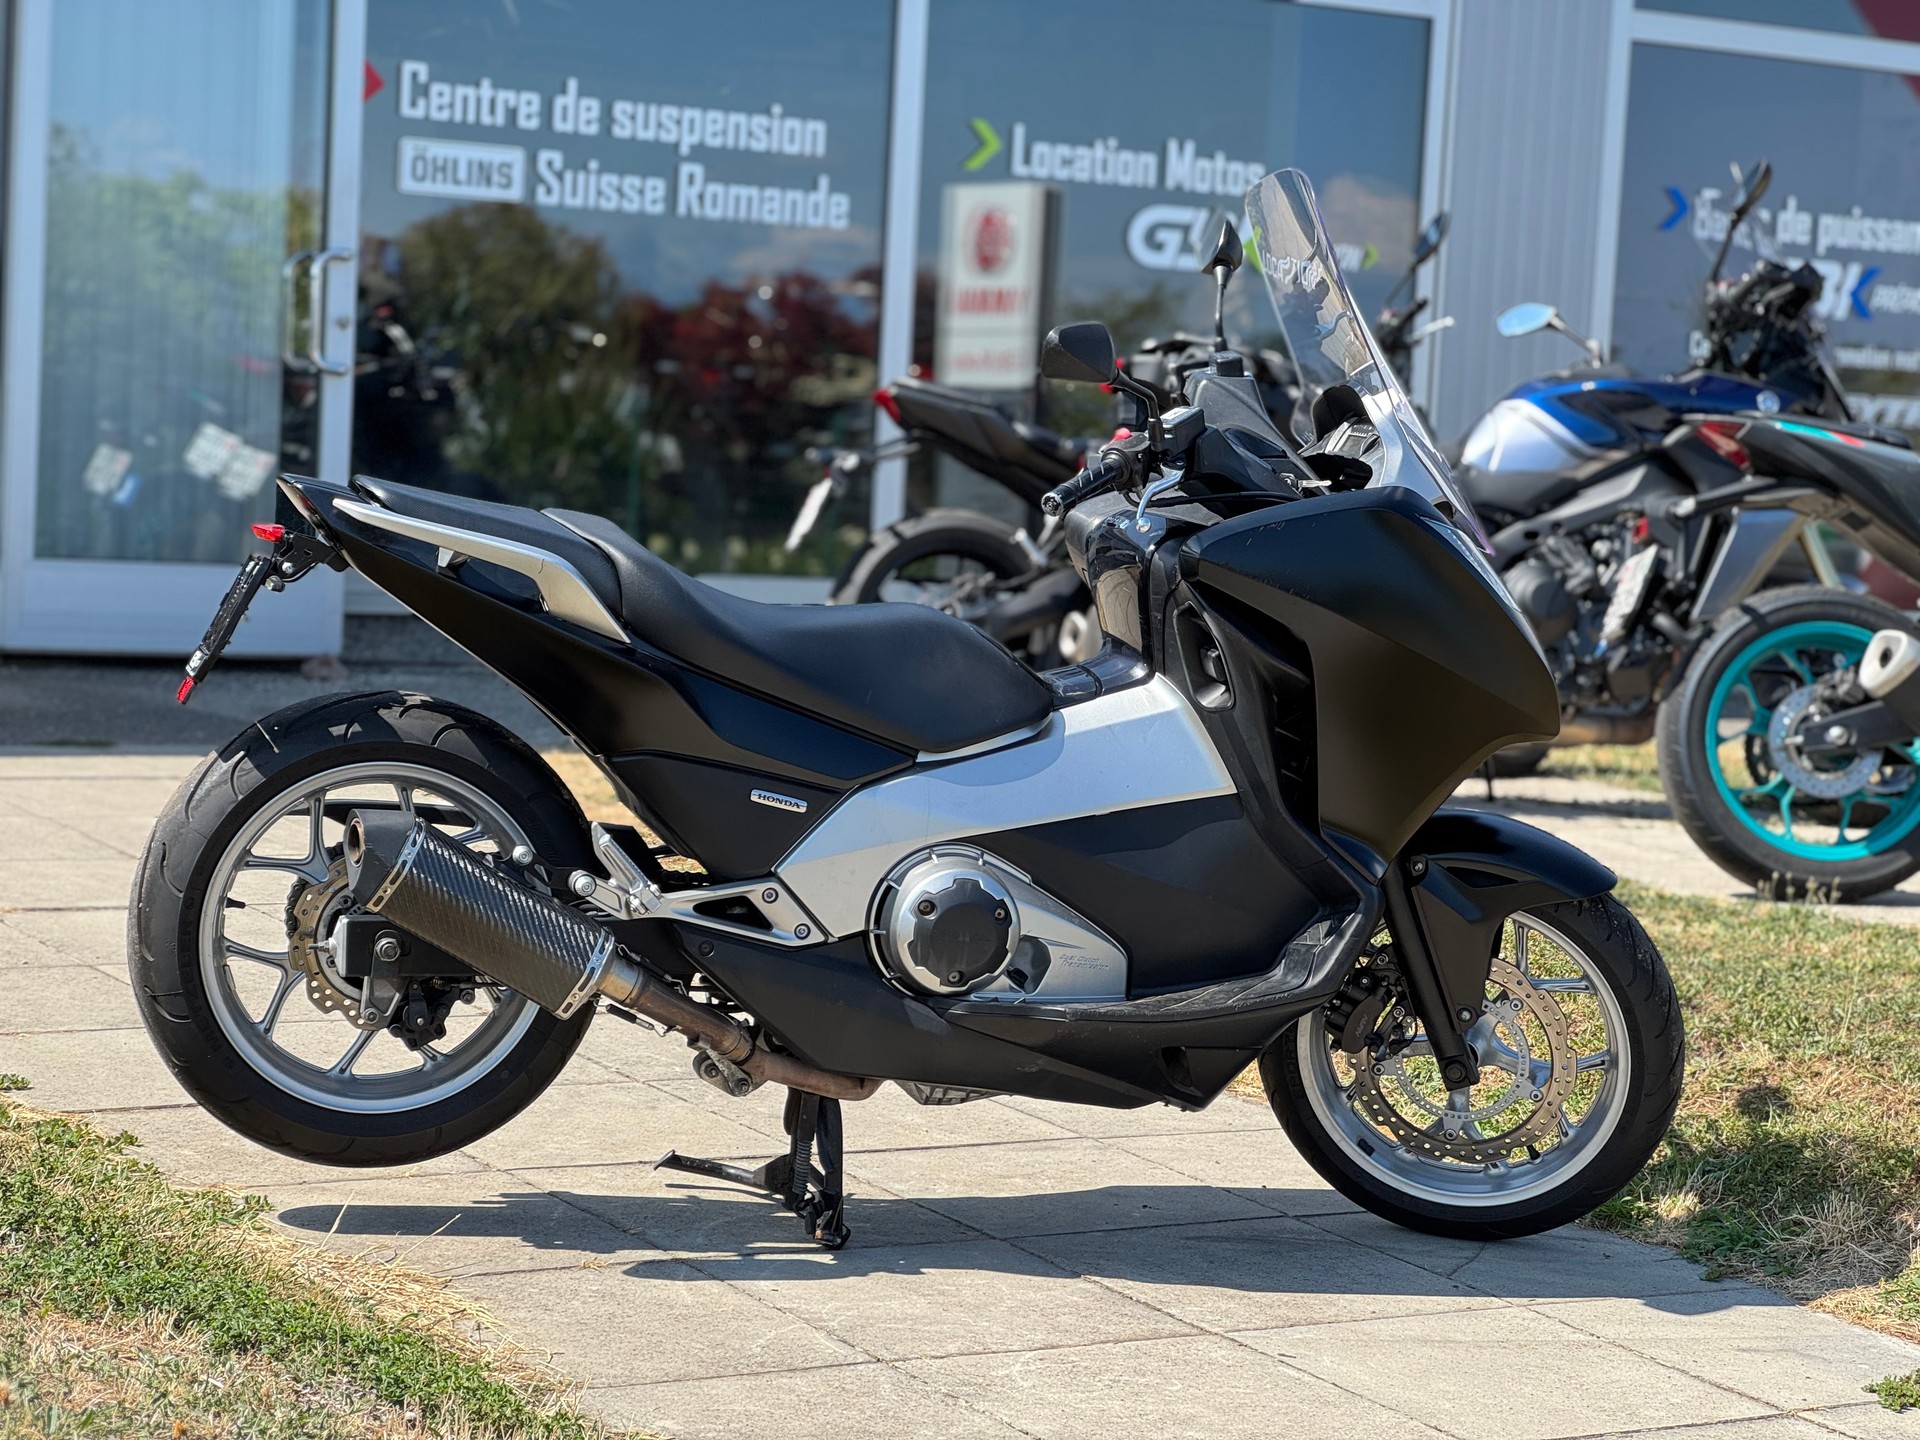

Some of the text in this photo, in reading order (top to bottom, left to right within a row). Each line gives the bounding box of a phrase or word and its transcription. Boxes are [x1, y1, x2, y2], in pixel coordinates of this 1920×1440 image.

[400, 60, 828, 159] Centre de suspension
[410, 144, 515, 191] ÖHLINS
[535, 149, 851, 229] Suisse Romande
[1010, 121, 1266, 198] Location Motos
[757, 793, 801, 809] HONDA
